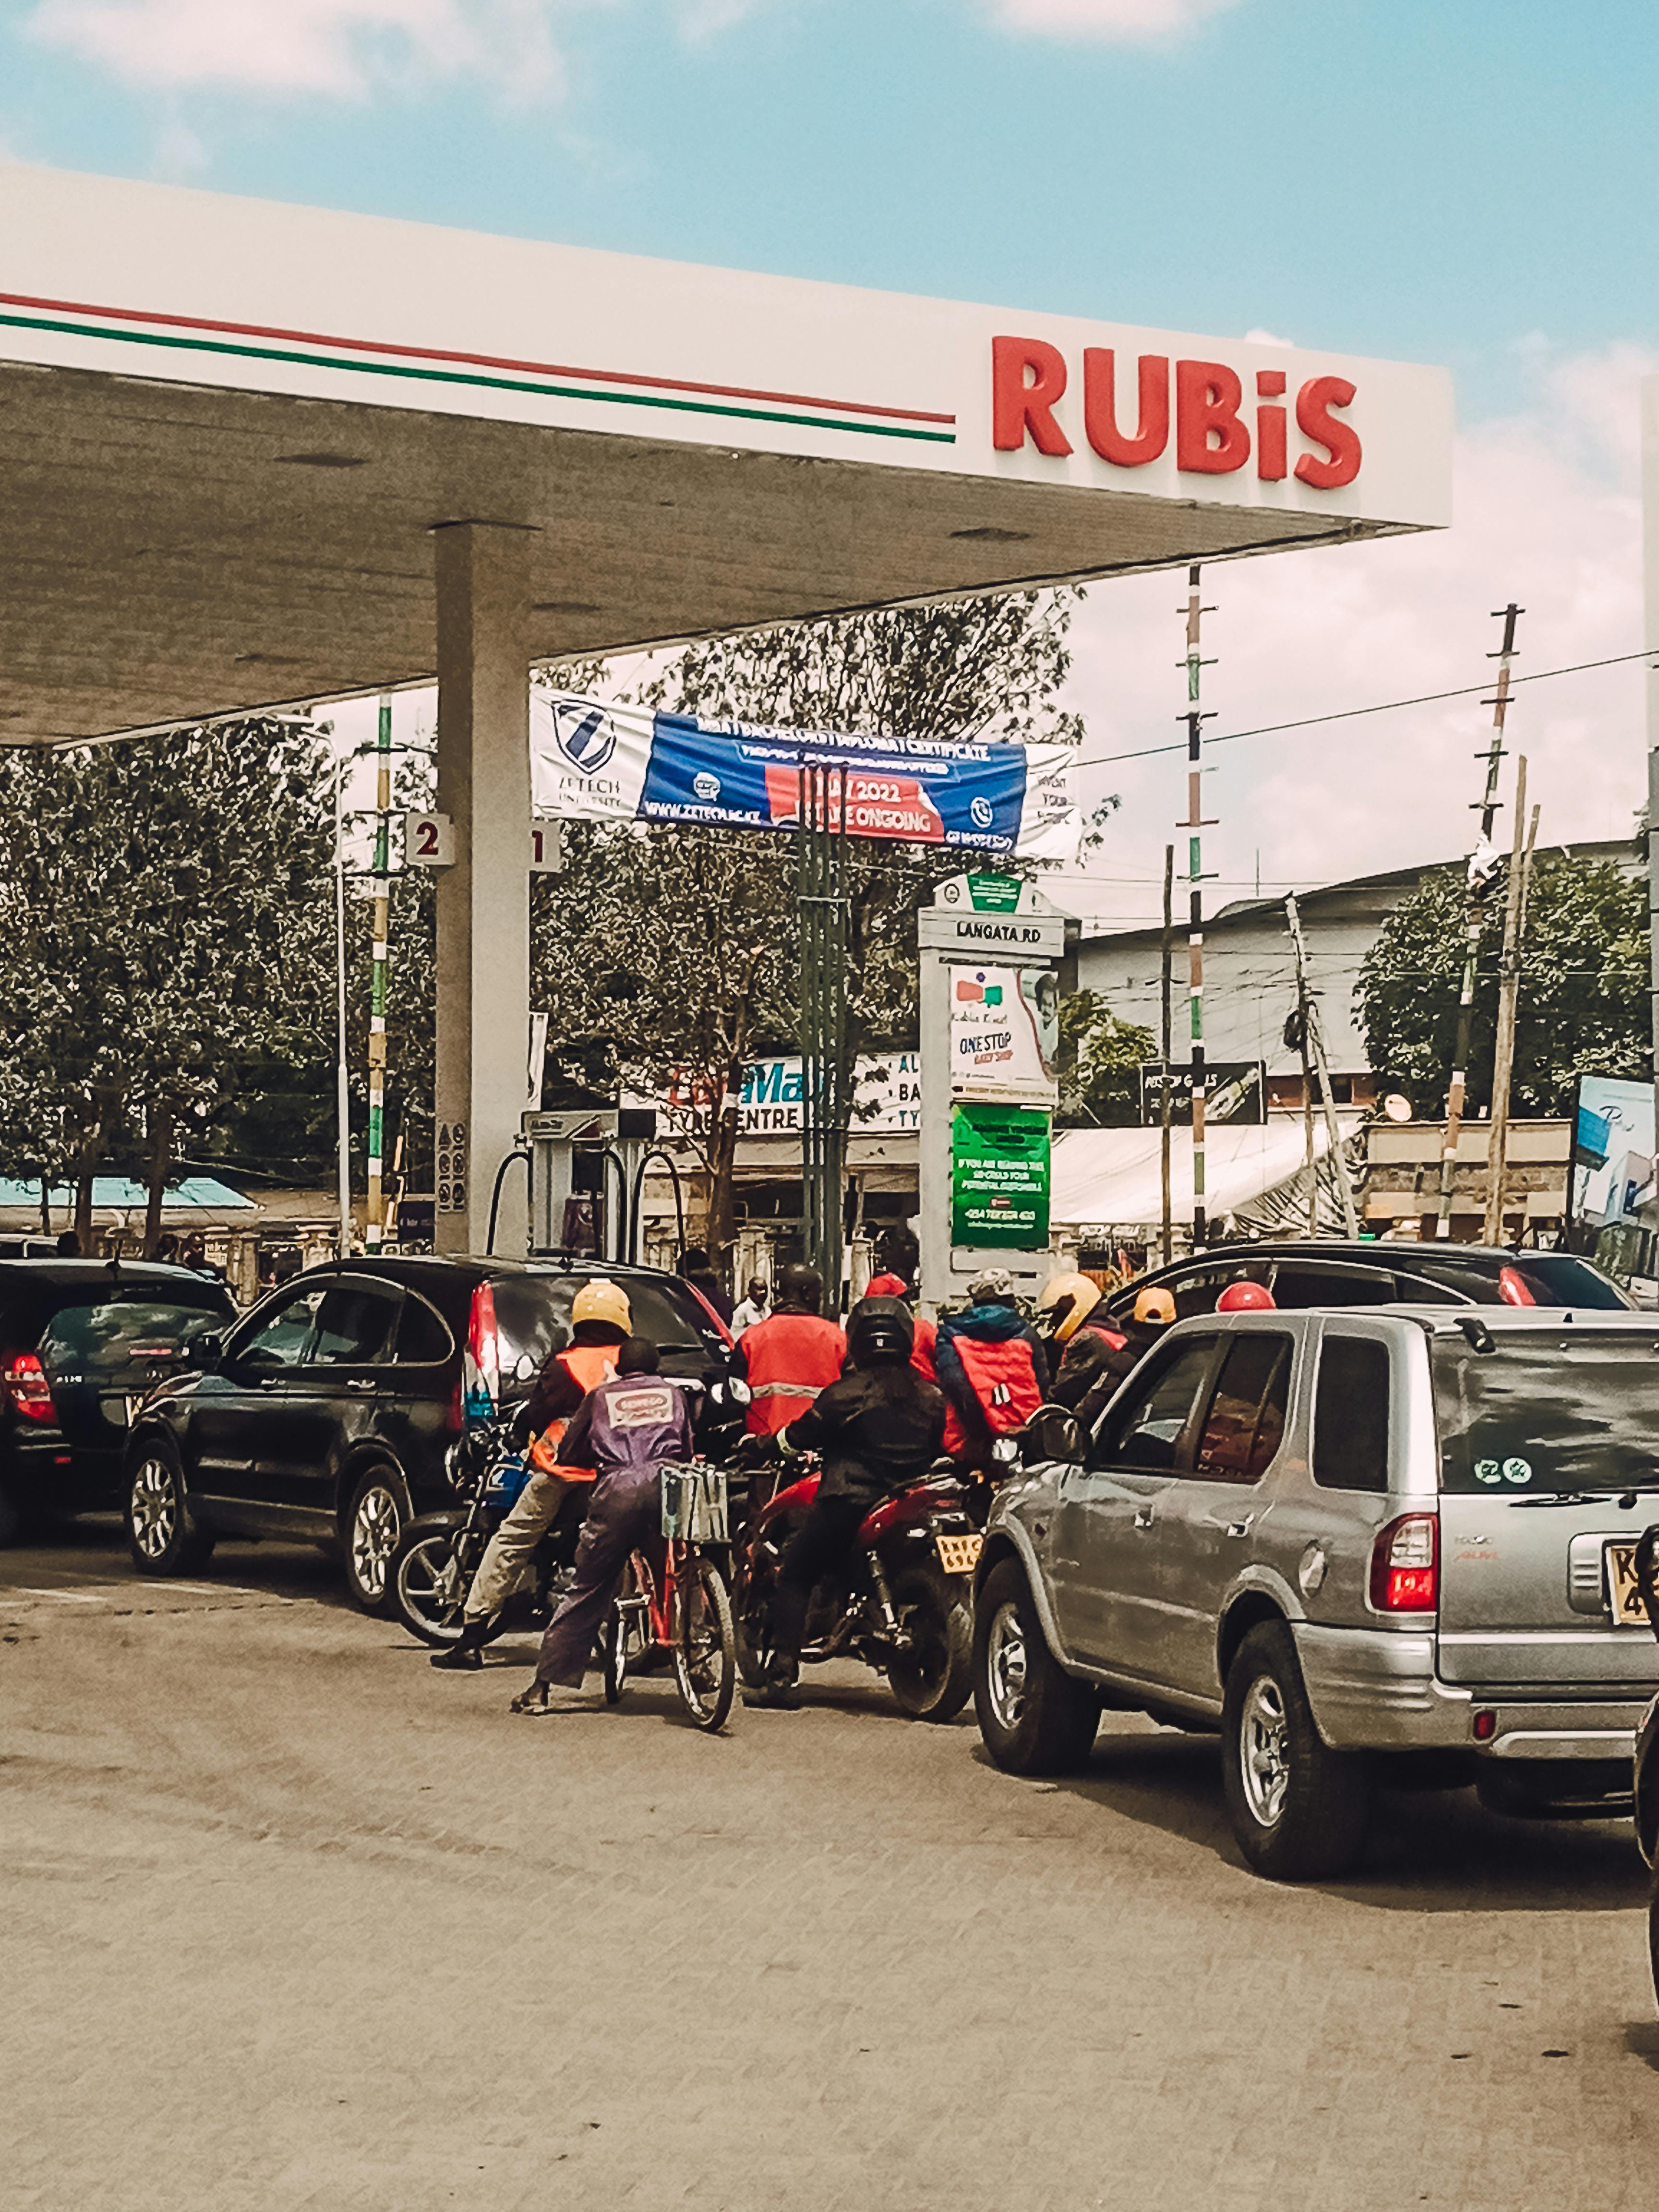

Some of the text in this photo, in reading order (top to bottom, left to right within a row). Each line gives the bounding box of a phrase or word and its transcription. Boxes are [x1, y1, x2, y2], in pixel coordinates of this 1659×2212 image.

[992, 336, 1362, 490] RUBiS
[906, 739, 991, 761] CERTIFICATE
[856, 781, 902, 803] 2022
[856, 807, 931, 832] ONGOING
[416, 821, 439, 855] 2
[531, 830, 543, 863] 1
[957, 921, 1041, 943] LANGATA RD
[726, 1108, 798, 1130] ENTRE
